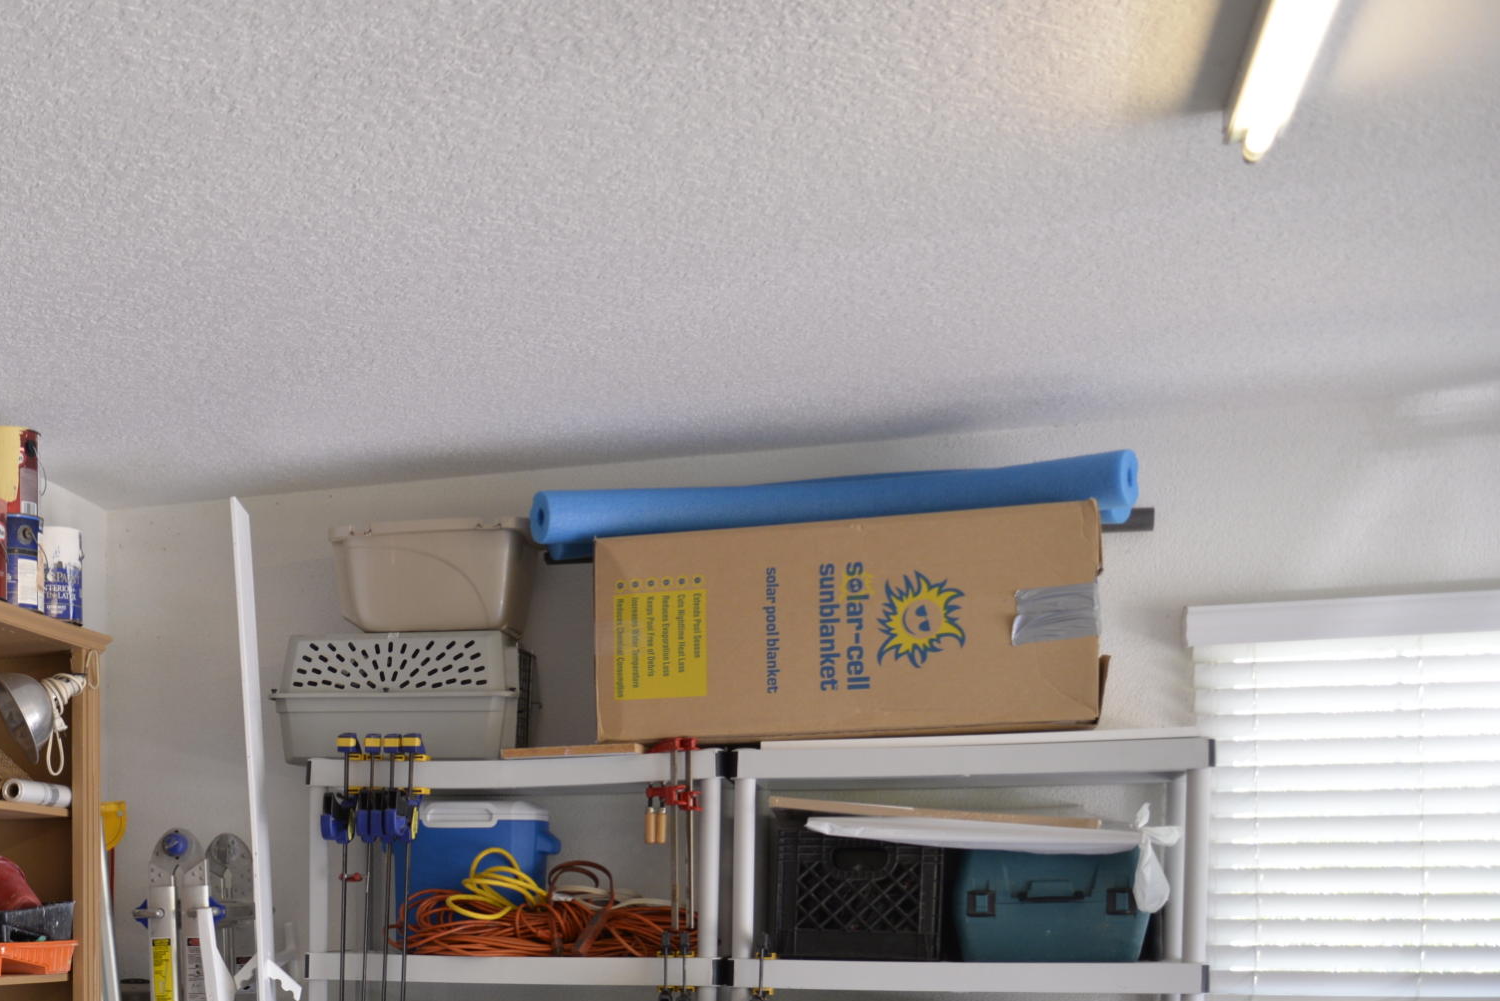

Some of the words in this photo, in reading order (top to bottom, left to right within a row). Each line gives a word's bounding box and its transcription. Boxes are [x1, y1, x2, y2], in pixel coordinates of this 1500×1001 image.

[765, 567, 780, 604] solar
[762, 605, 780, 637] pool
[819, 563, 841, 692] sunblanket
[846, 561, 871, 690] solar-cell
[765, 638, 780, 694] blanket
